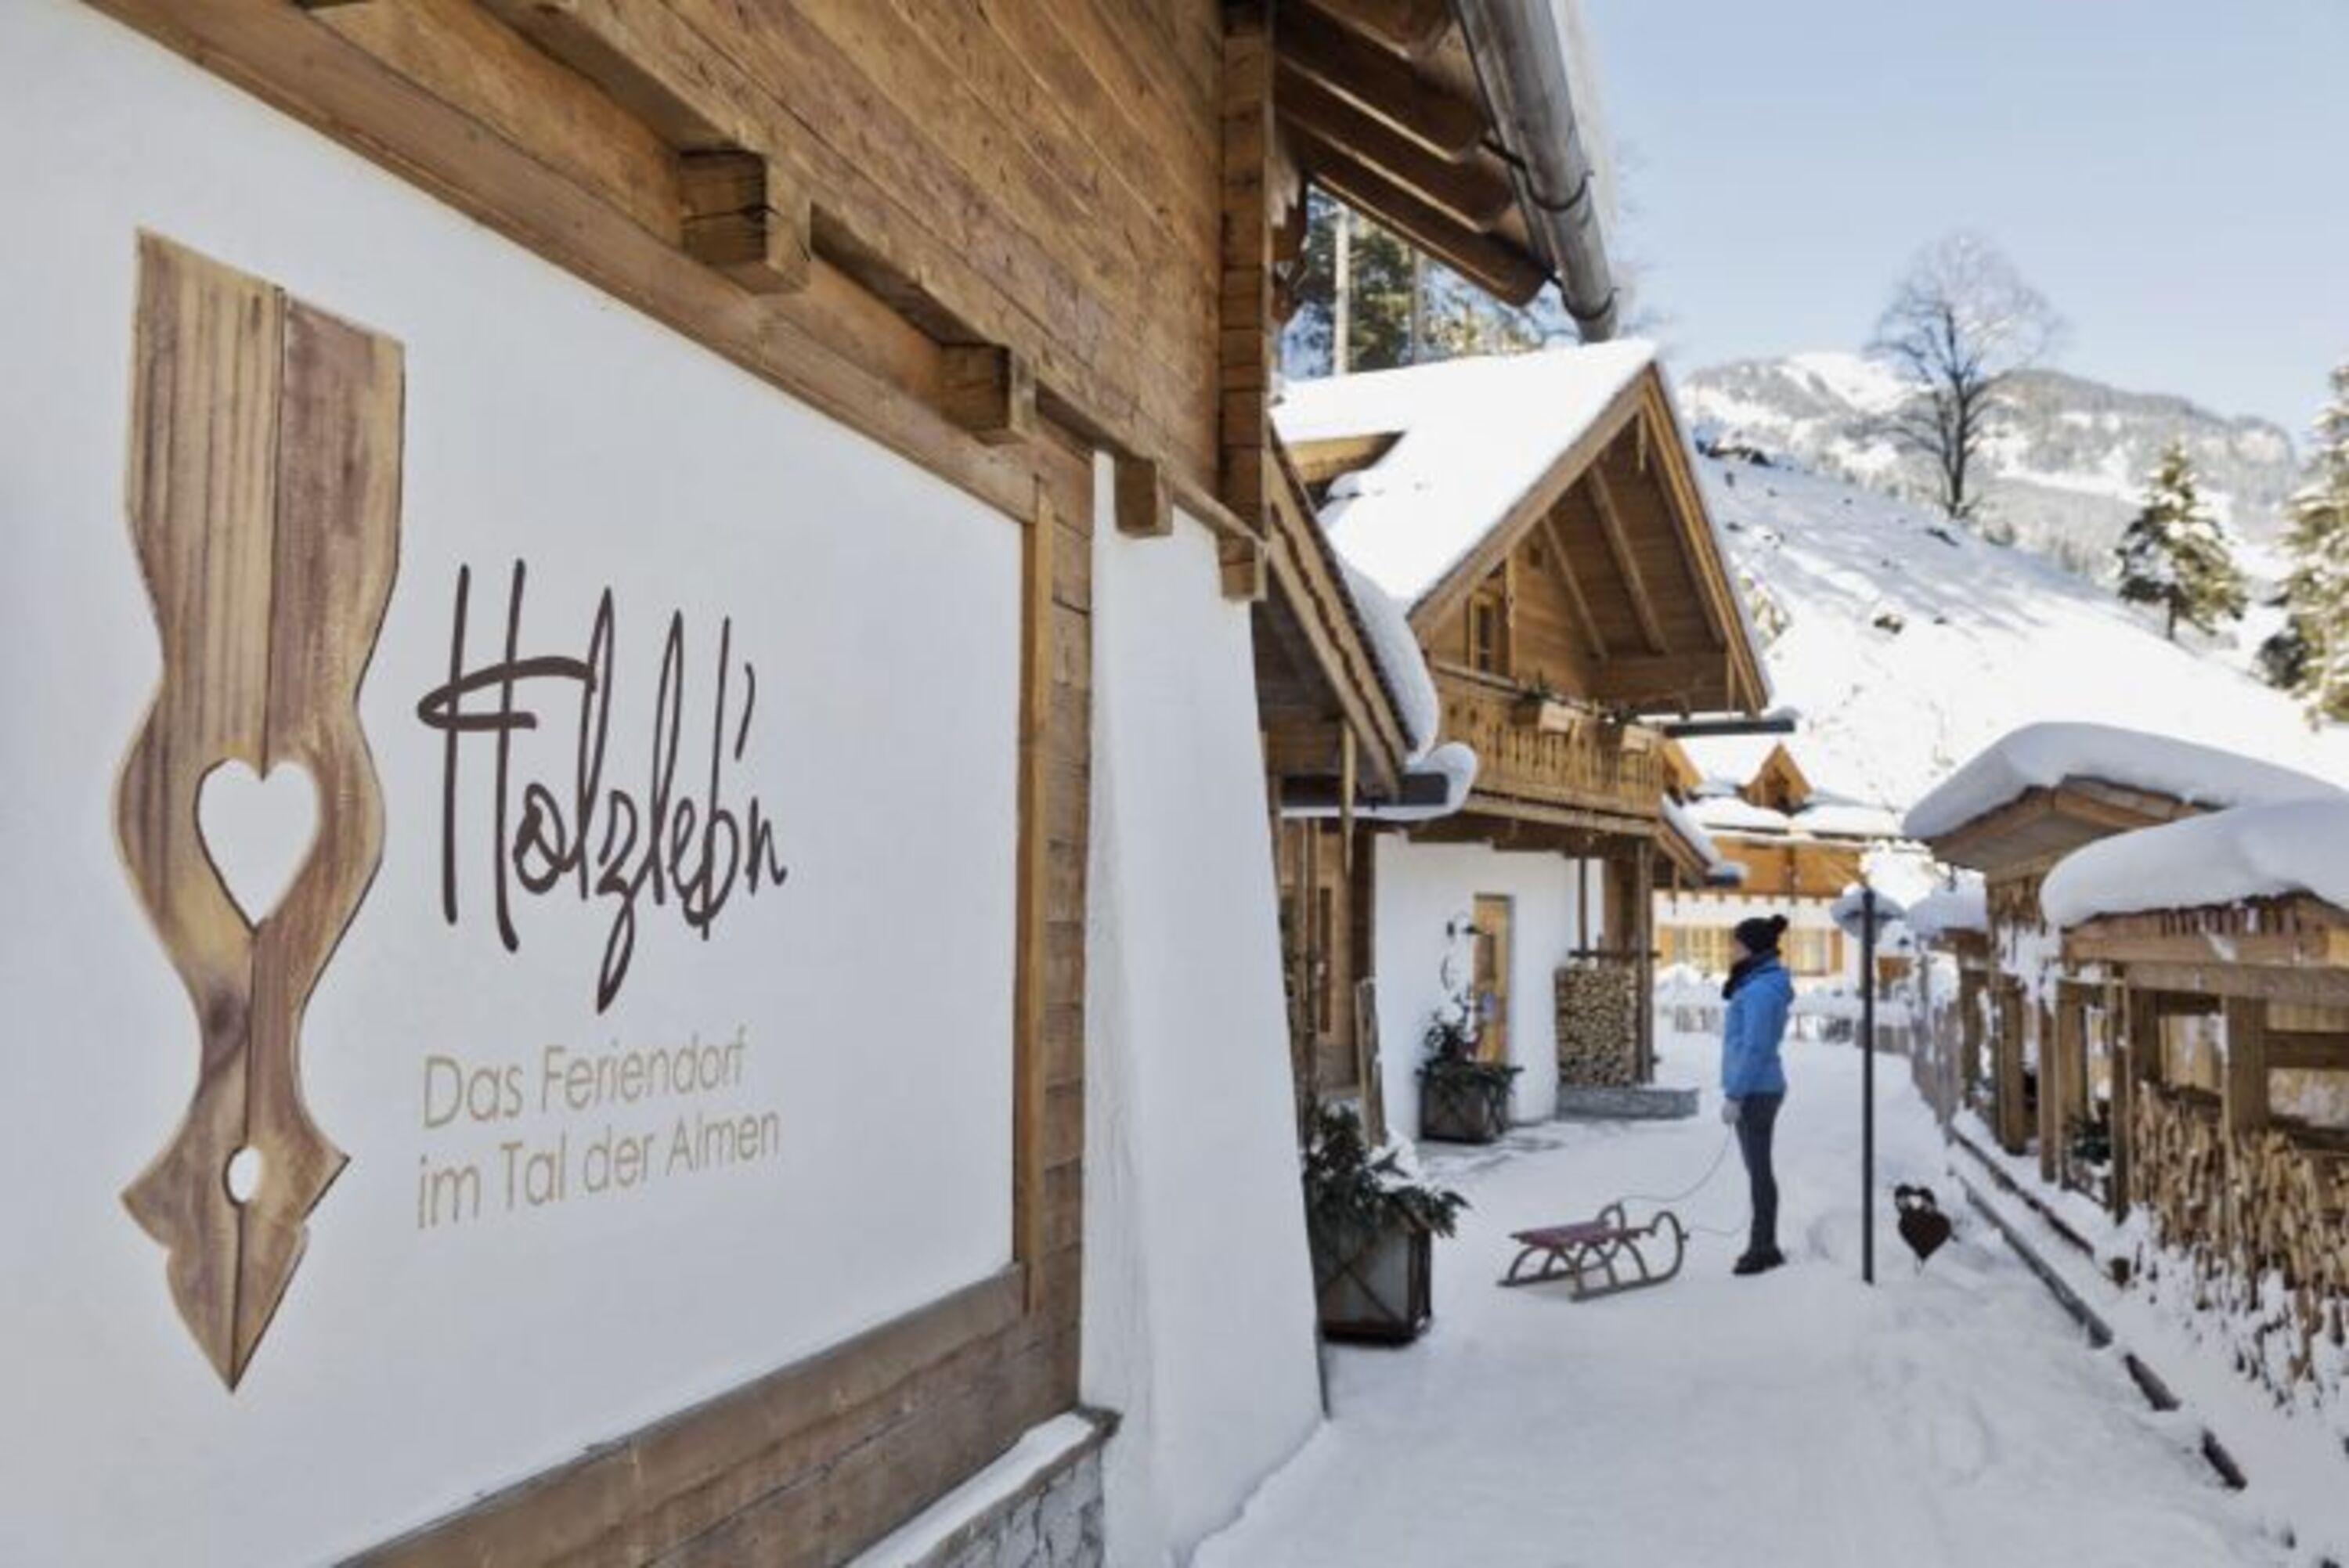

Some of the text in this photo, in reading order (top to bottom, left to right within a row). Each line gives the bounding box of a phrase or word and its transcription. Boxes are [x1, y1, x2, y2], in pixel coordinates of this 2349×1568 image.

[417, 558, 788, 1015] Holzleb'n
[422, 1024, 747, 1130] Das Feriendorf
[417, 1109, 781, 1230] im Tal der Almen
